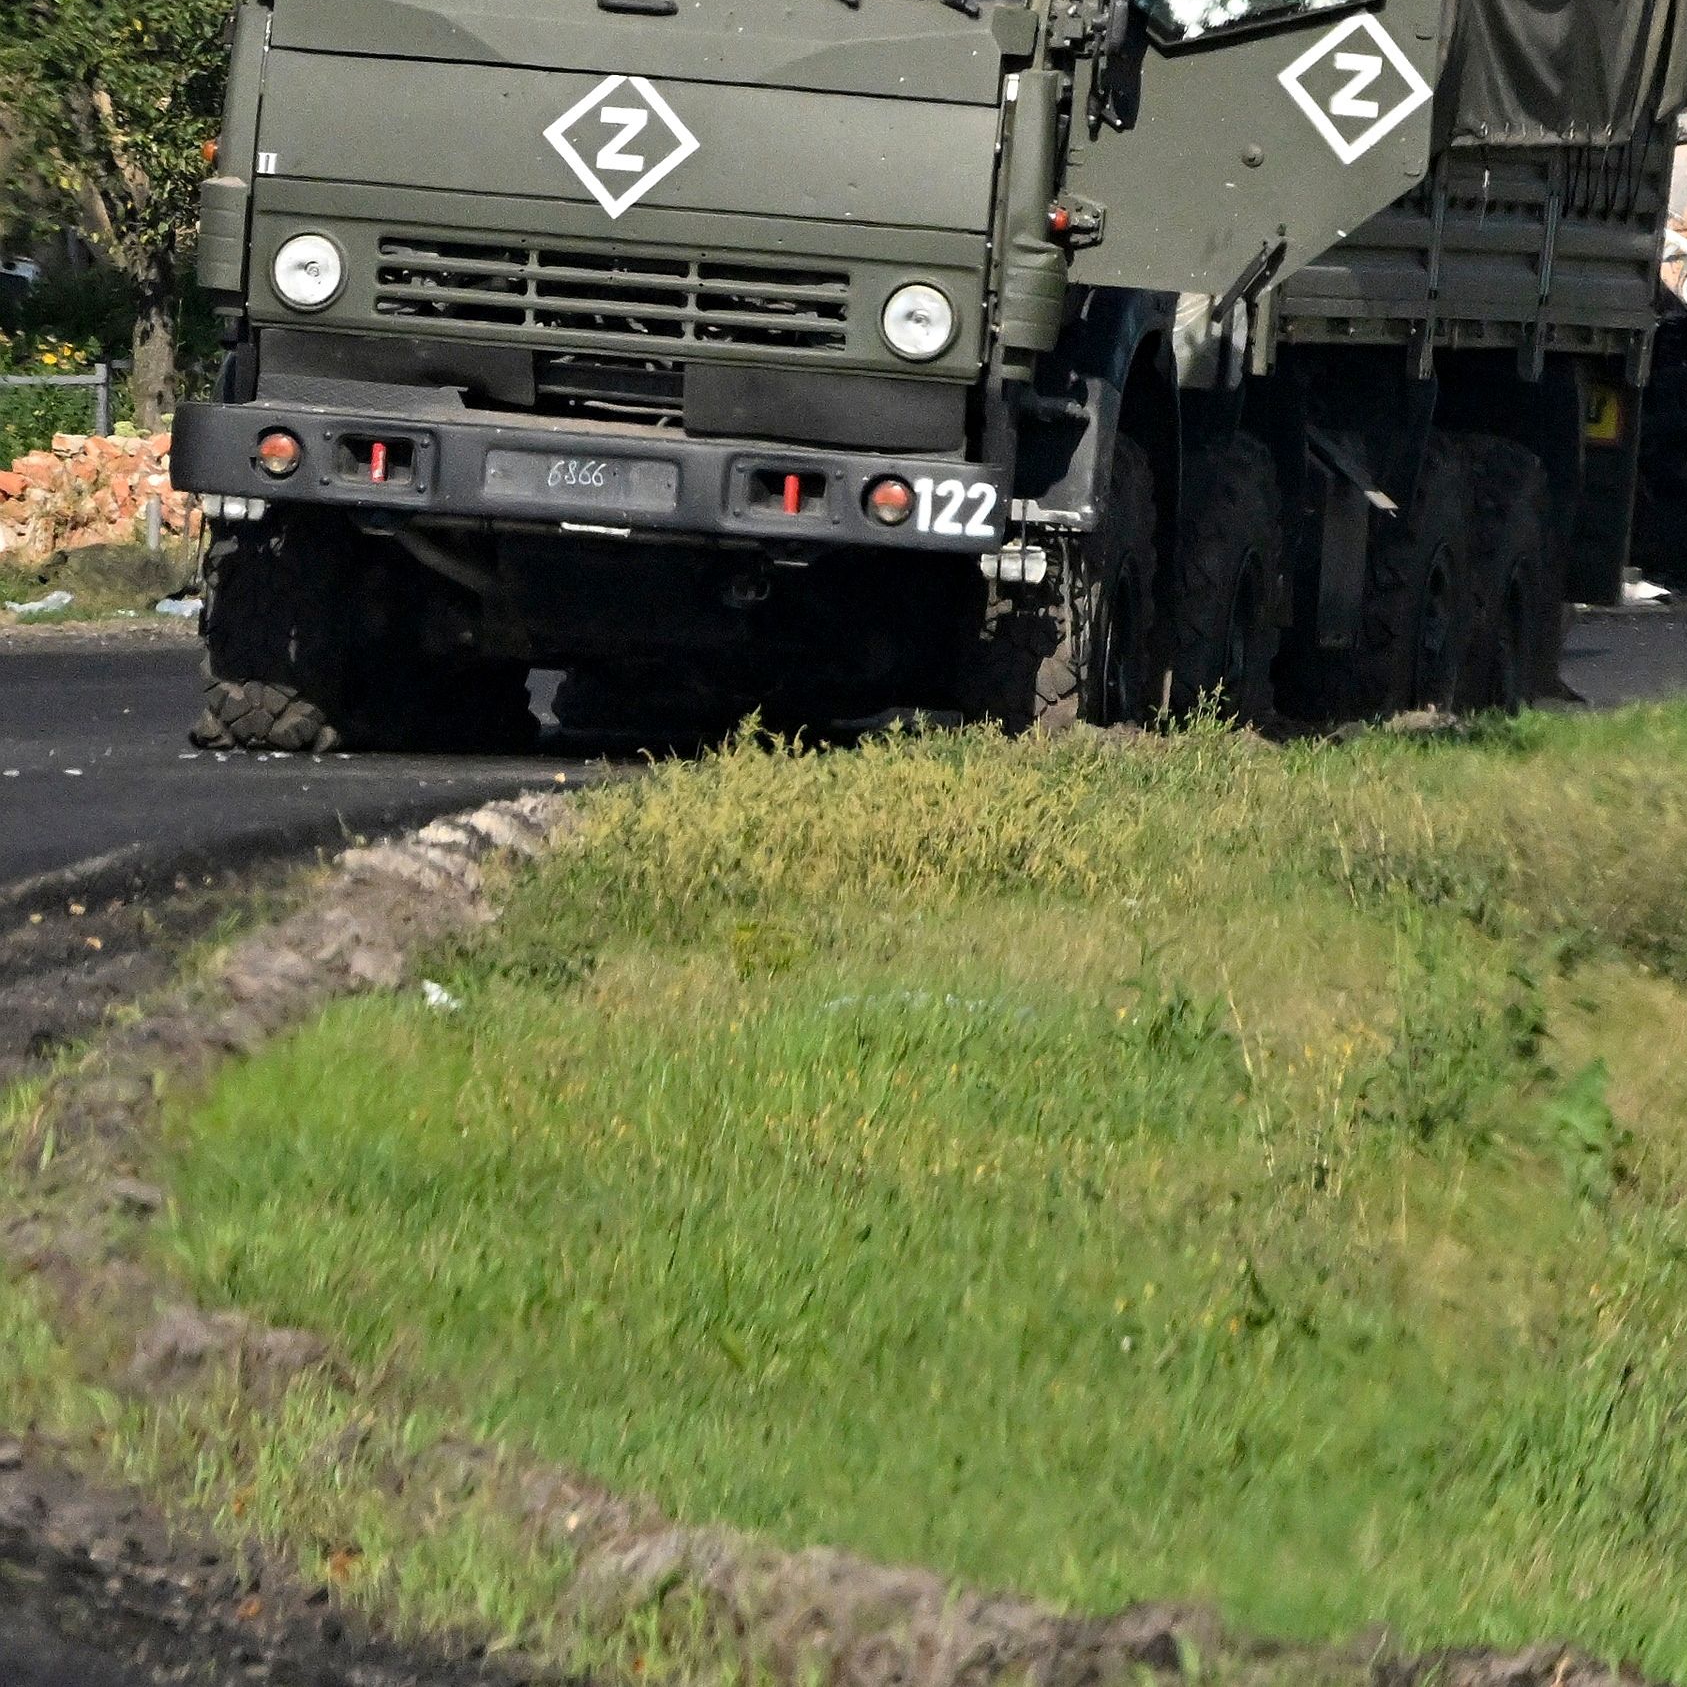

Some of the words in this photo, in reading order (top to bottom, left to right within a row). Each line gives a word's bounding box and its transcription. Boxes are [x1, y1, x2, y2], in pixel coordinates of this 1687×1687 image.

[1330, 52, 1383, 119] Z
[596, 106, 648, 172] Z
[914, 478, 997, 537] 122
